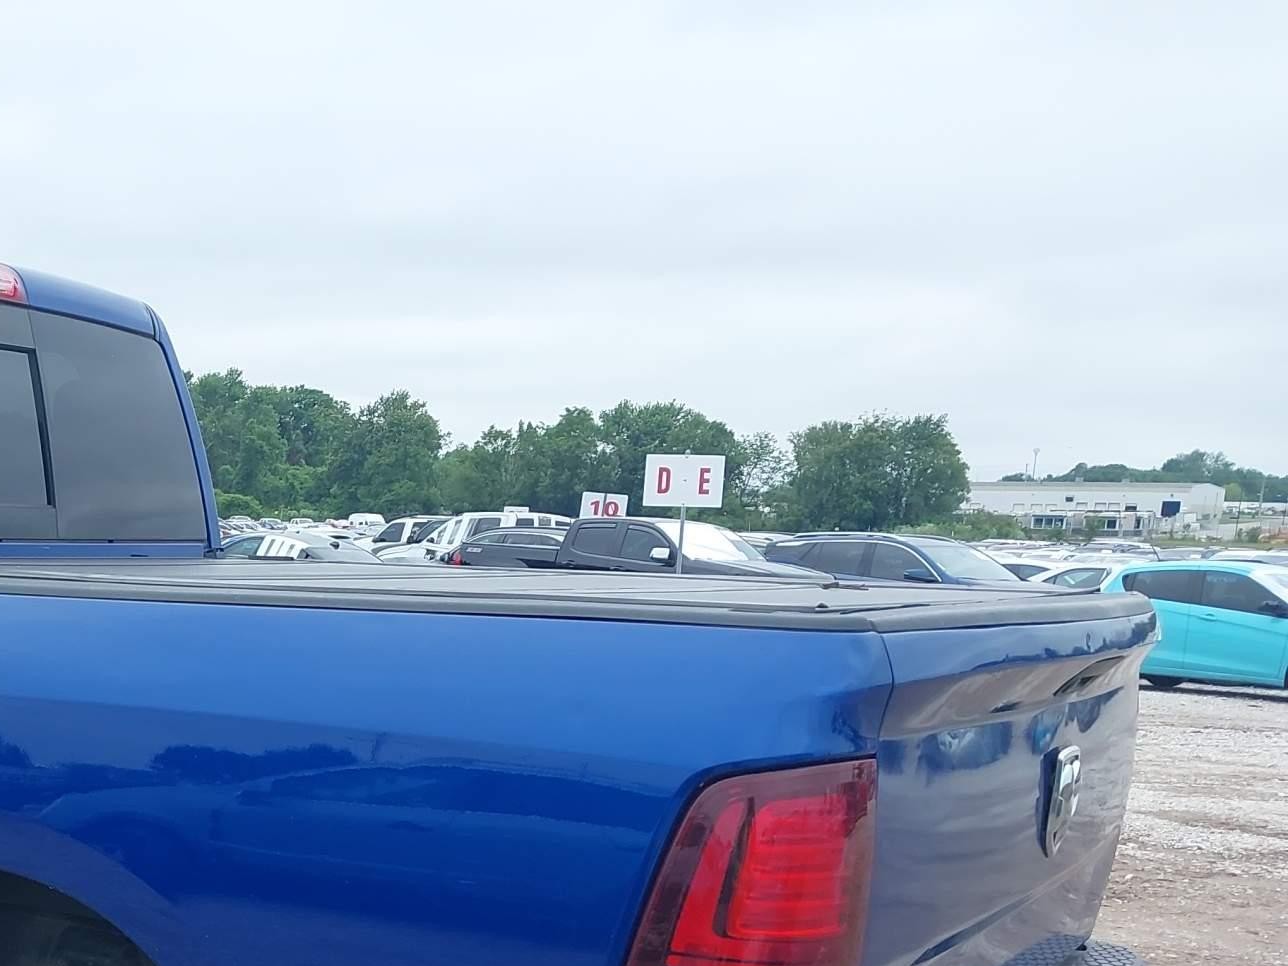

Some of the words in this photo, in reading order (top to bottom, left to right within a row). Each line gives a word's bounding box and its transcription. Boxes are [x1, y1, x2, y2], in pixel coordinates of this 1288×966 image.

[657, 466, 672, 494] D
[698, 467, 711, 495] E
[590, 500, 619, 517] 10
